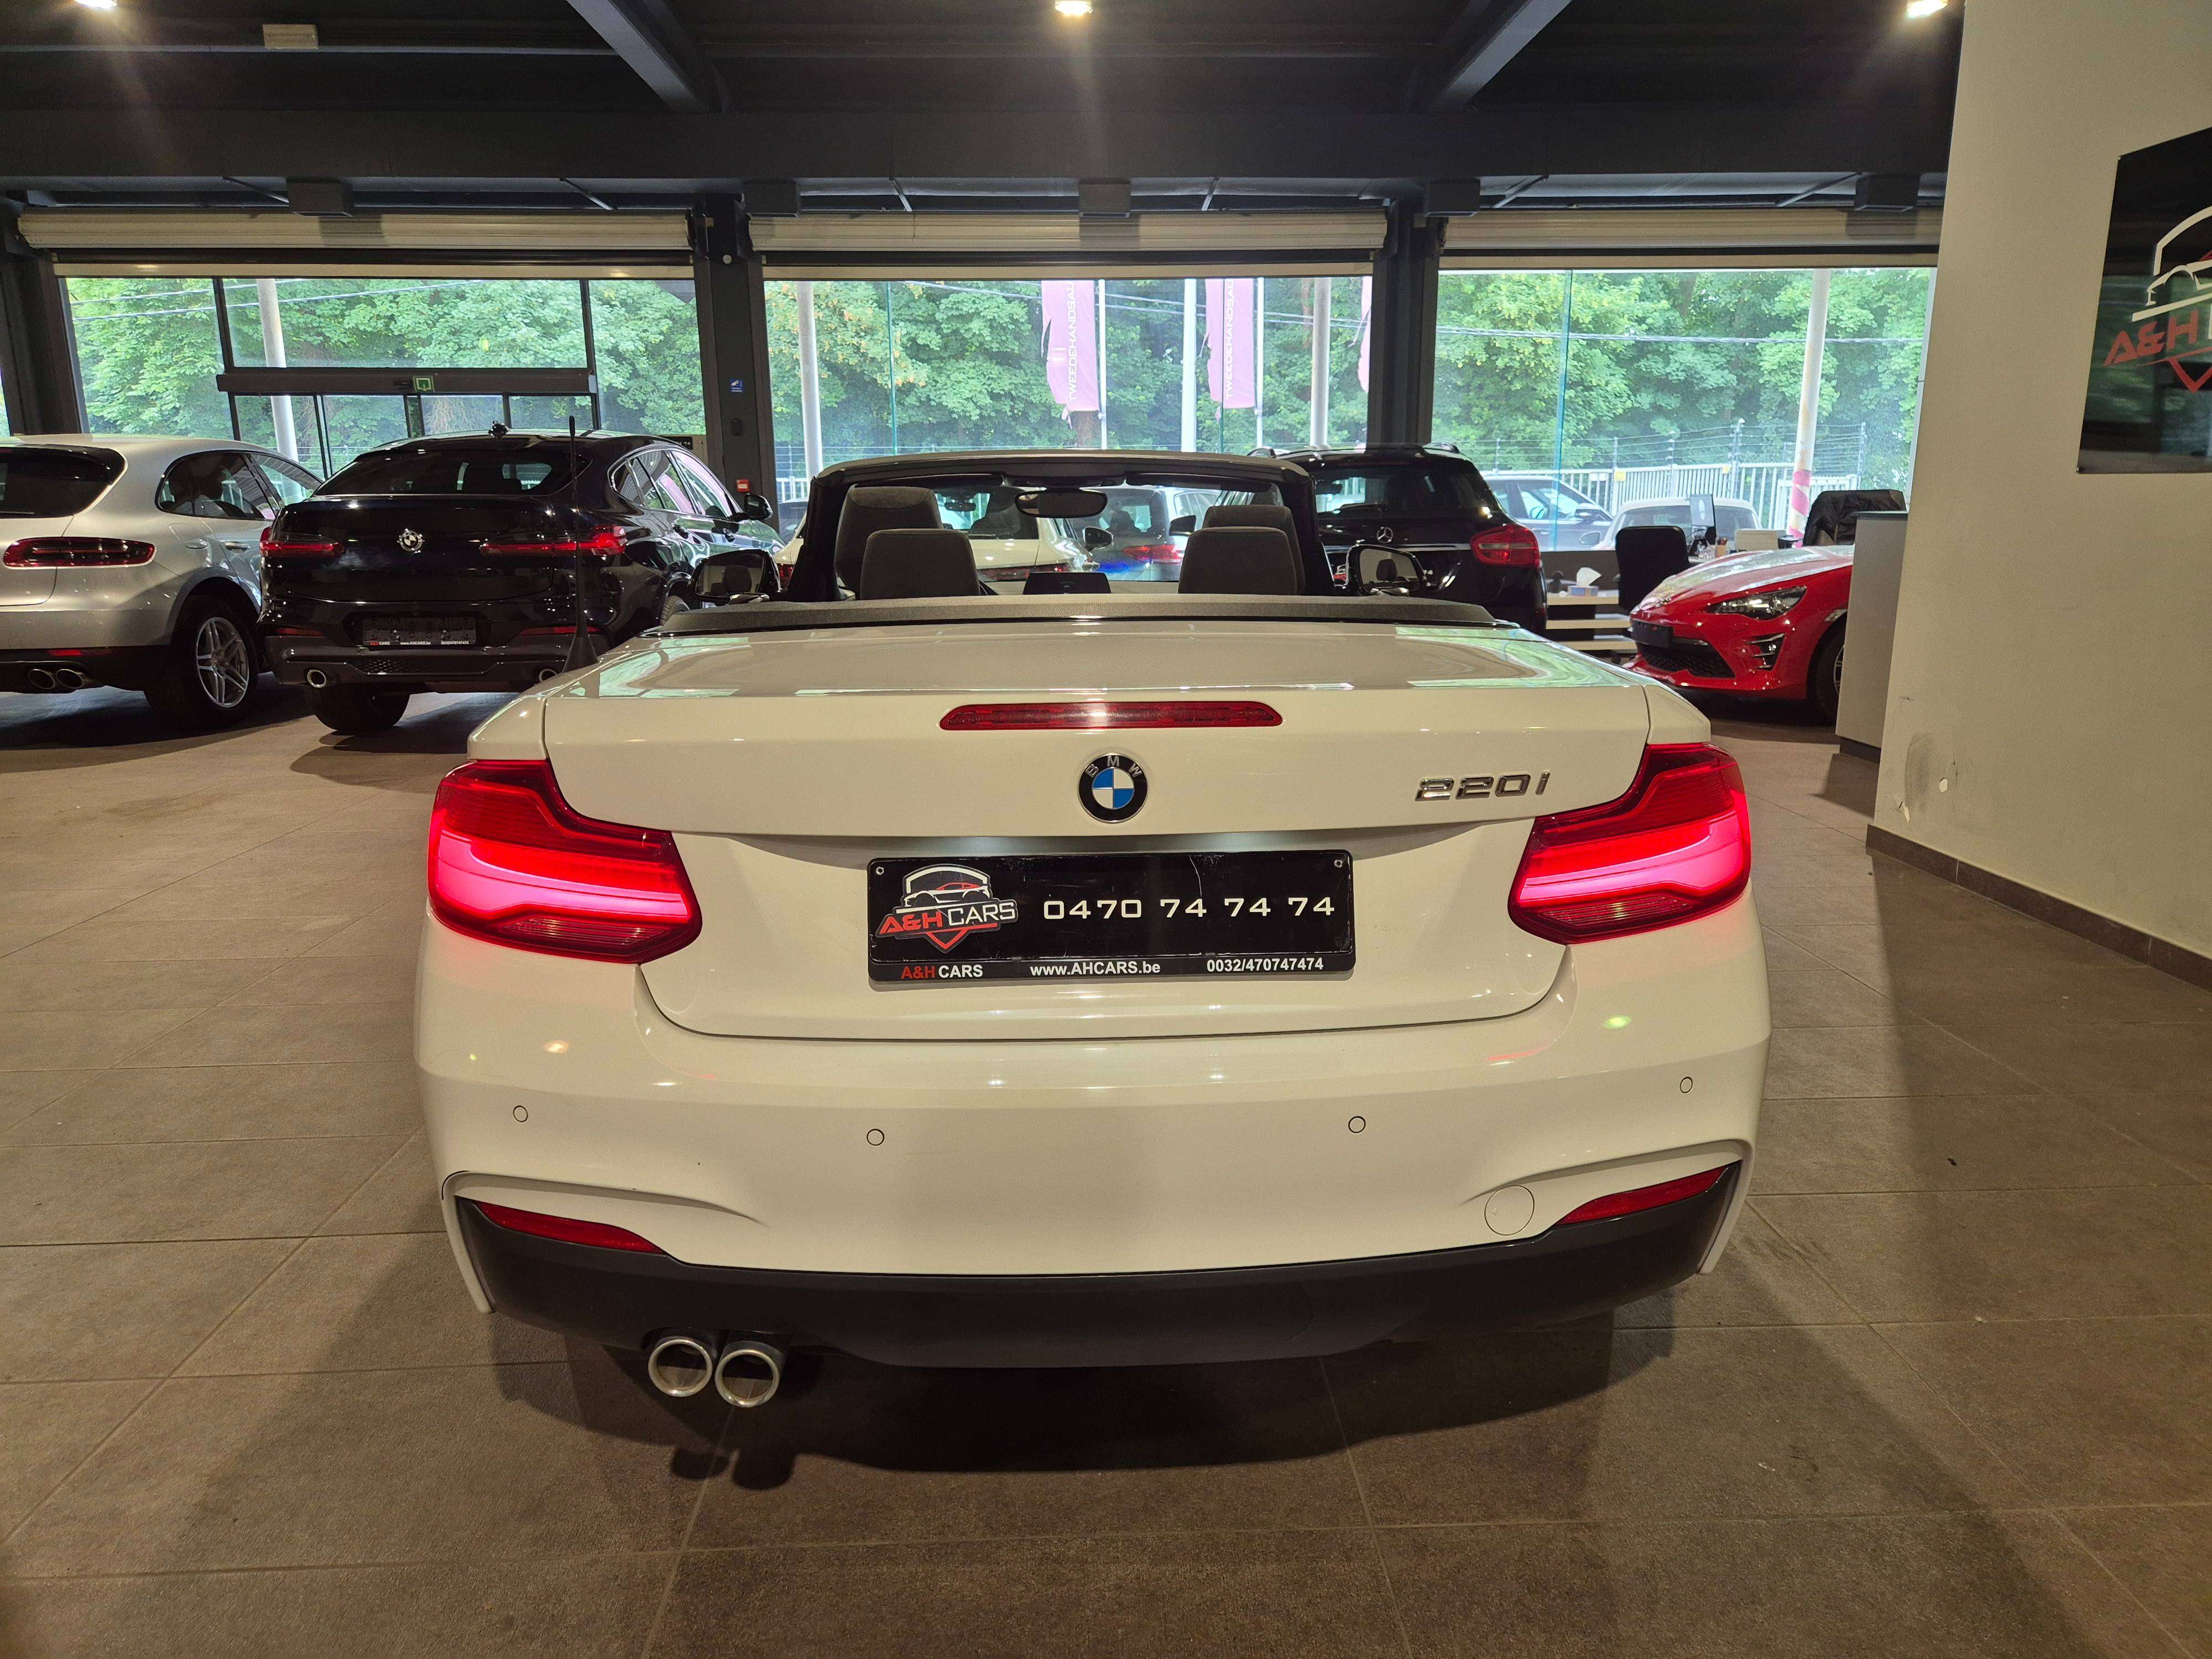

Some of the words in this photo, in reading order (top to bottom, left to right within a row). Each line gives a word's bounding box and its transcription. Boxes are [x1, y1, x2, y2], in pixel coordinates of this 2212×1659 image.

[2103, 310, 2199, 368] A&H
[1085, 755, 1142, 778] BMW
[1415, 772, 1551, 802] 220i
[879, 911, 943, 935] A&H
[947, 902, 1015, 926] CARS
[1044, 900, 1142, 919] 0470
[1160, 899, 1207, 918] 74
[1224, 898, 1271, 917] 74
[1288, 897, 1335, 916] 74
[901, 966, 936, 979] A&H
[938, 964, 983, 978] CARS
[1030, 961, 1161, 976] www.AHCARS.be
[1207, 957, 1324, 972] 0032/470747474
